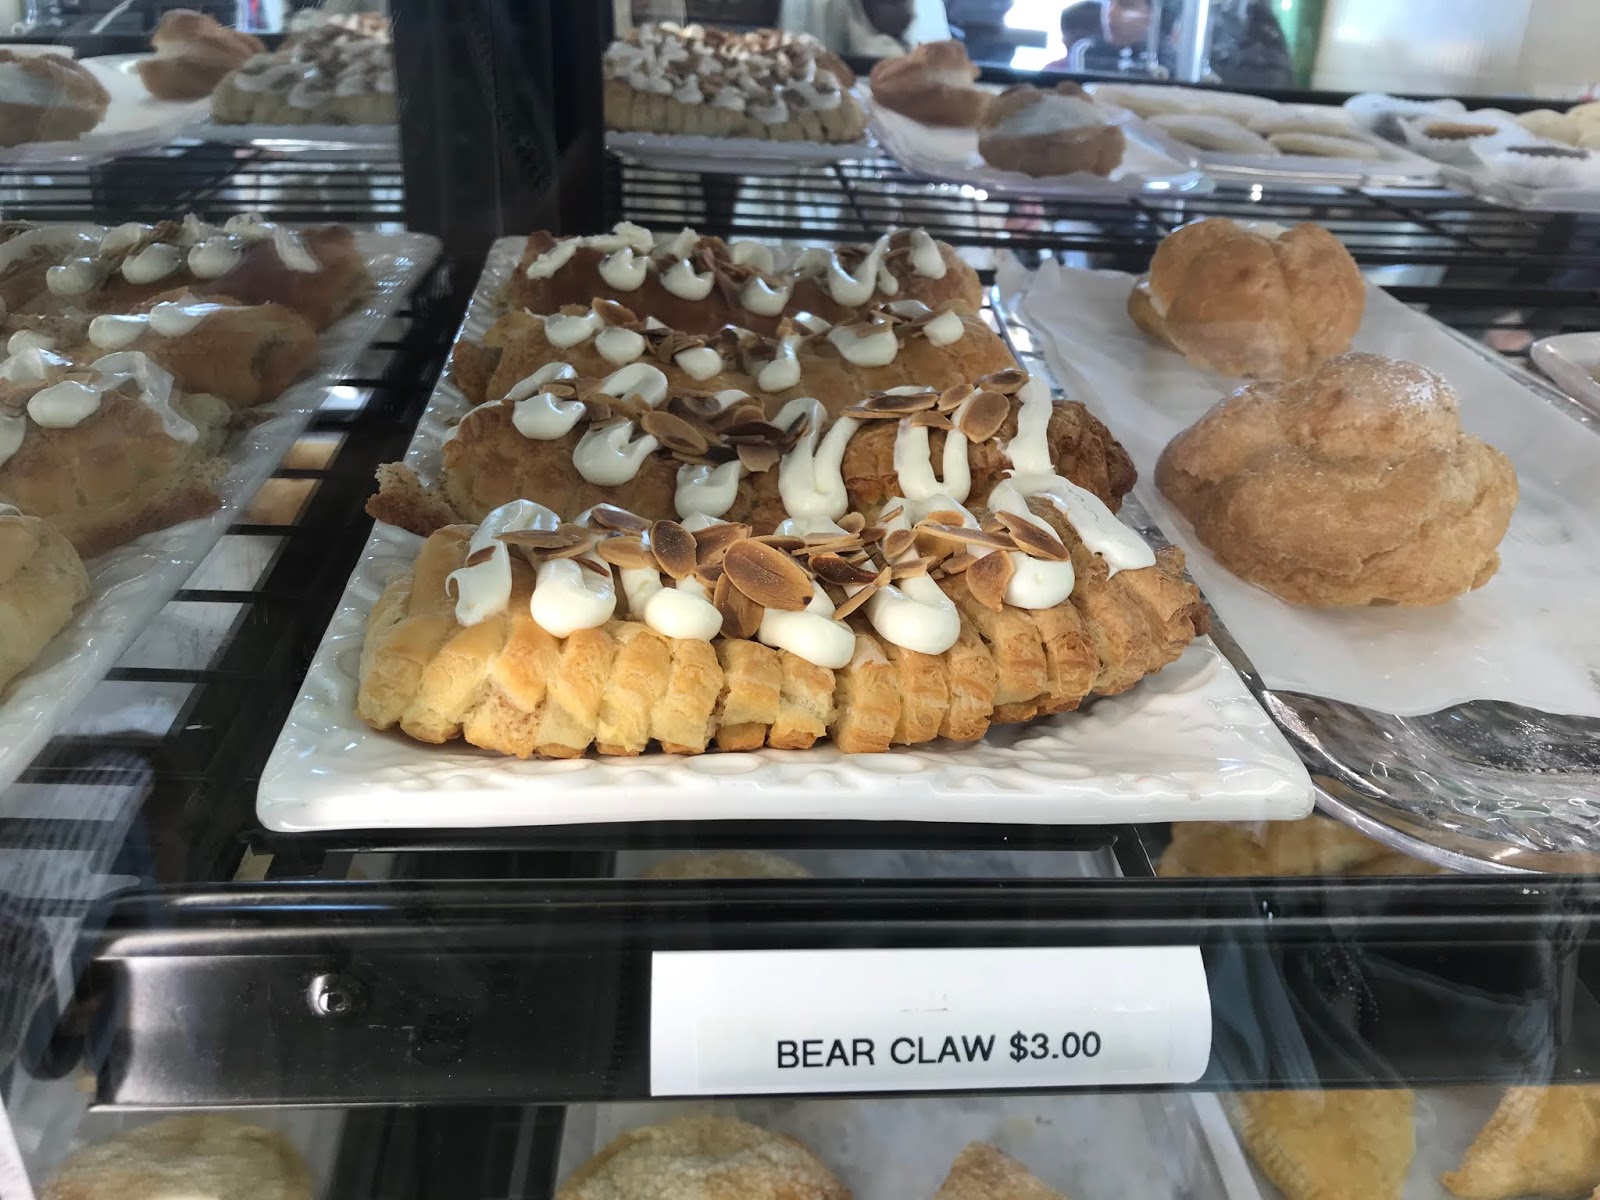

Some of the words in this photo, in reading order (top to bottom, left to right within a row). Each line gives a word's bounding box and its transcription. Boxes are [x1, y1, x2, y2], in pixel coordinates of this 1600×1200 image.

[777, 1039, 875, 1069] BEAR
[890, 1034, 996, 1065] CLAW
[1009, 1031, 1101, 1063] $3.00
